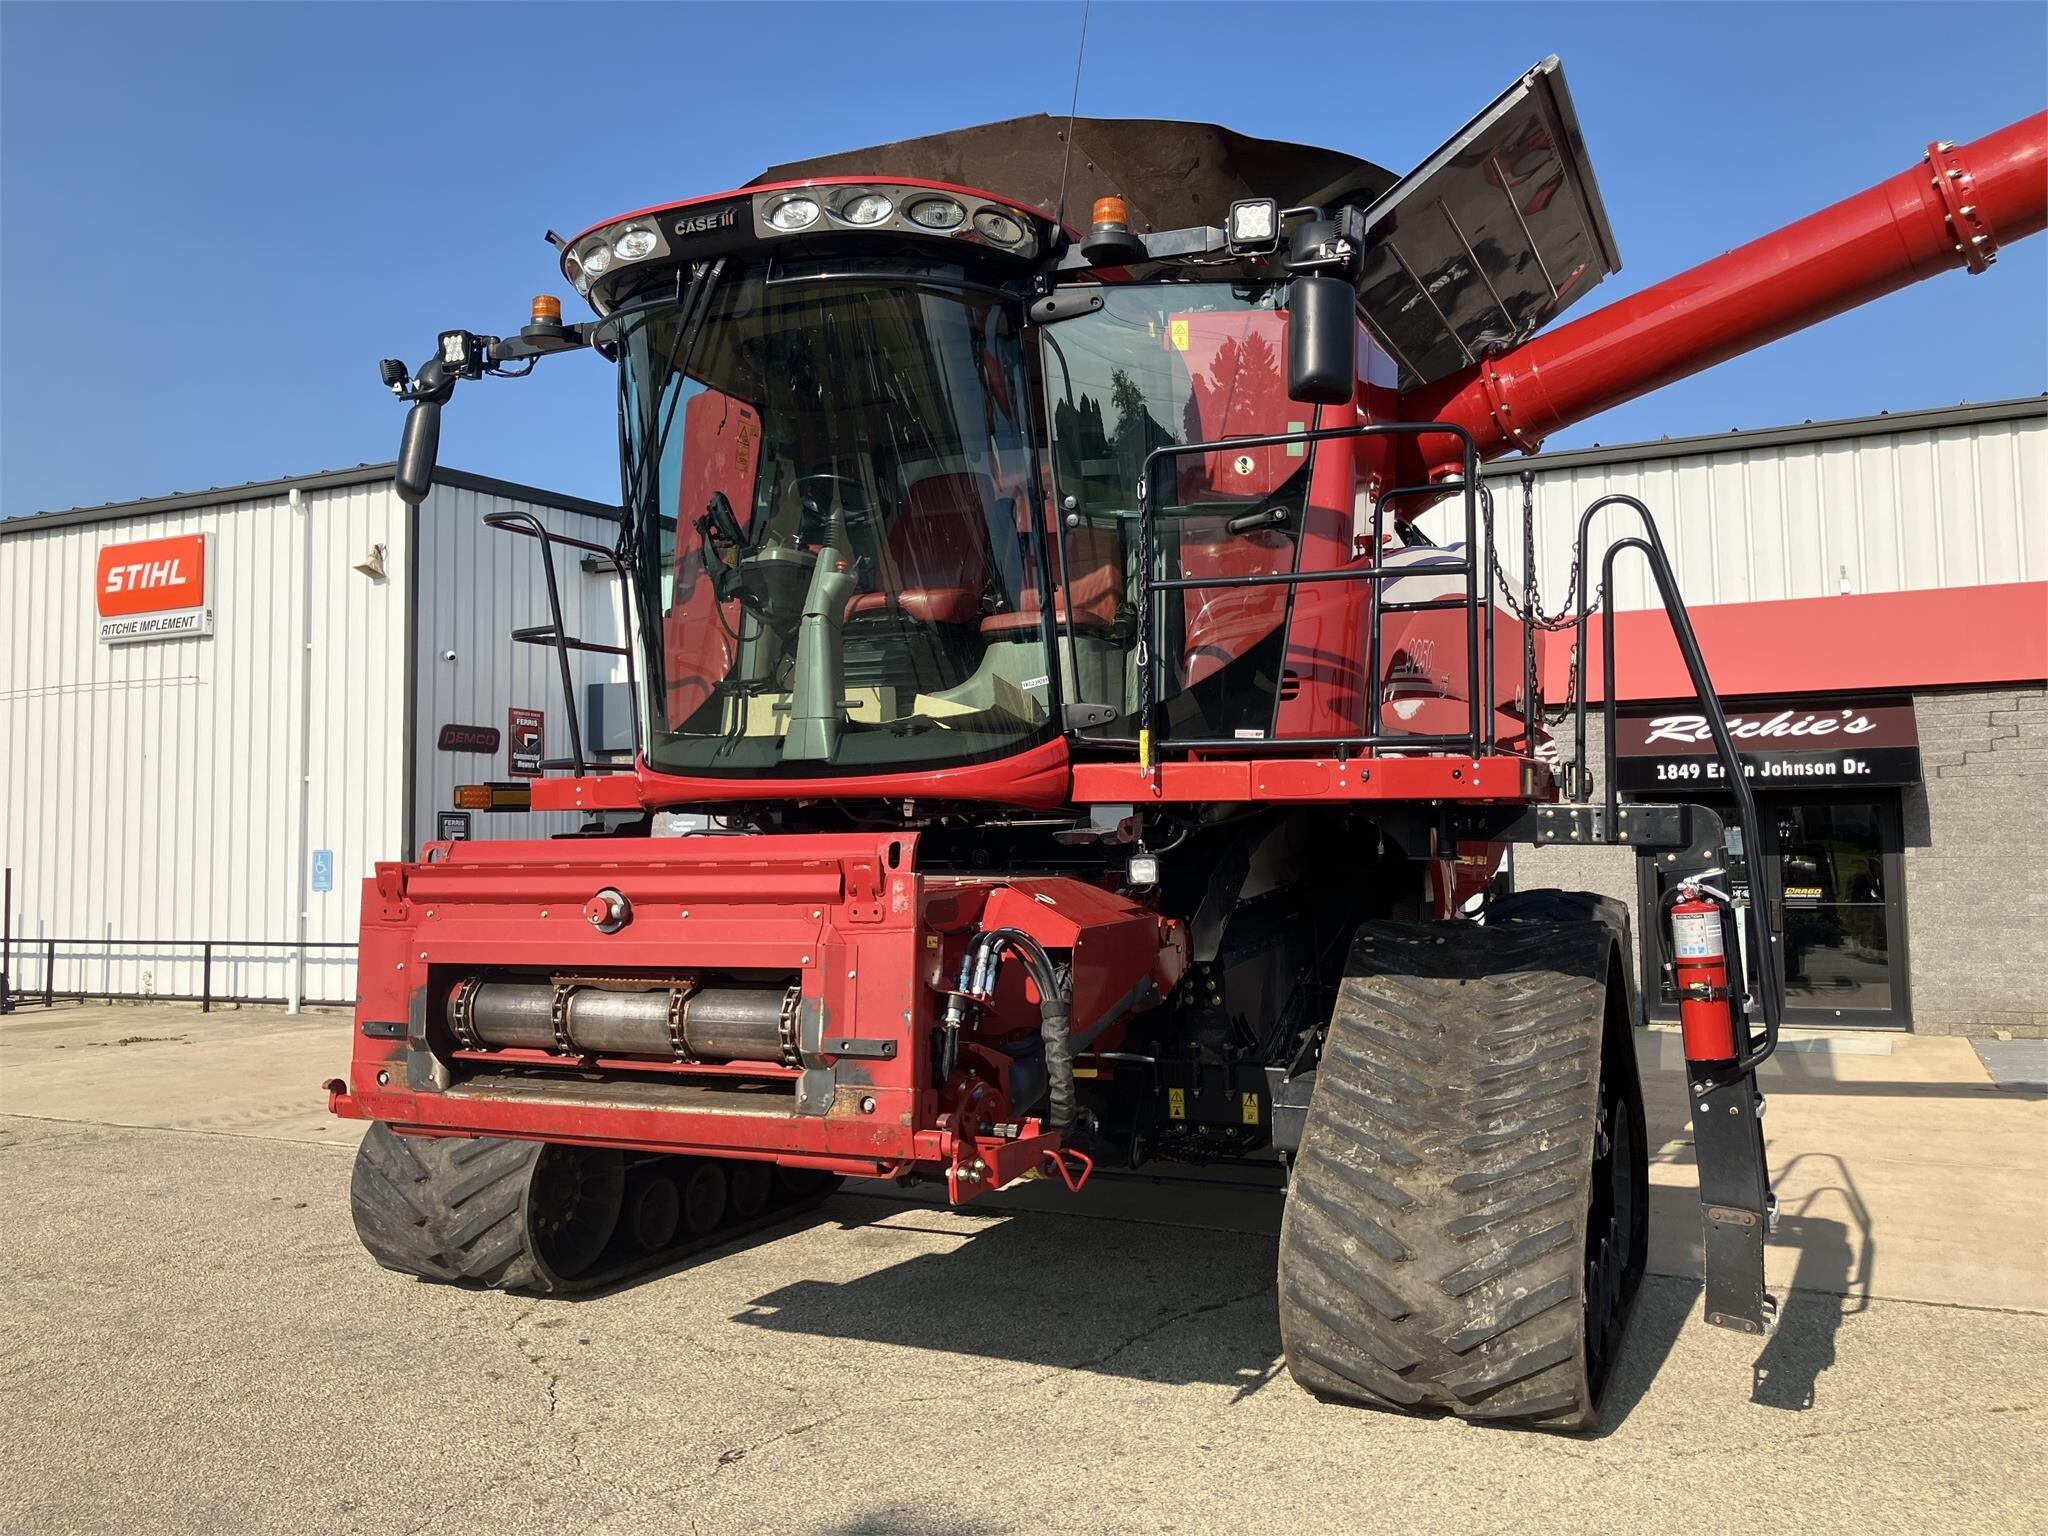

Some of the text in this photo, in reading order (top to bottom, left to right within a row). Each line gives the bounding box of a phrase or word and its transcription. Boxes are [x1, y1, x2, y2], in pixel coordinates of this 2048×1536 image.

[674, 216, 718, 235] CASE
[105, 558, 187, 593] STIHL
[101, 621, 138, 636] RITCHIE
[139, 615, 196, 632] IMPLEMENT
[516, 718, 538, 727] FERRIS
[443, 731, 497, 746] DEMCO
[1656, 758, 1871, 780] 1849 Ern Johnson Dr.
